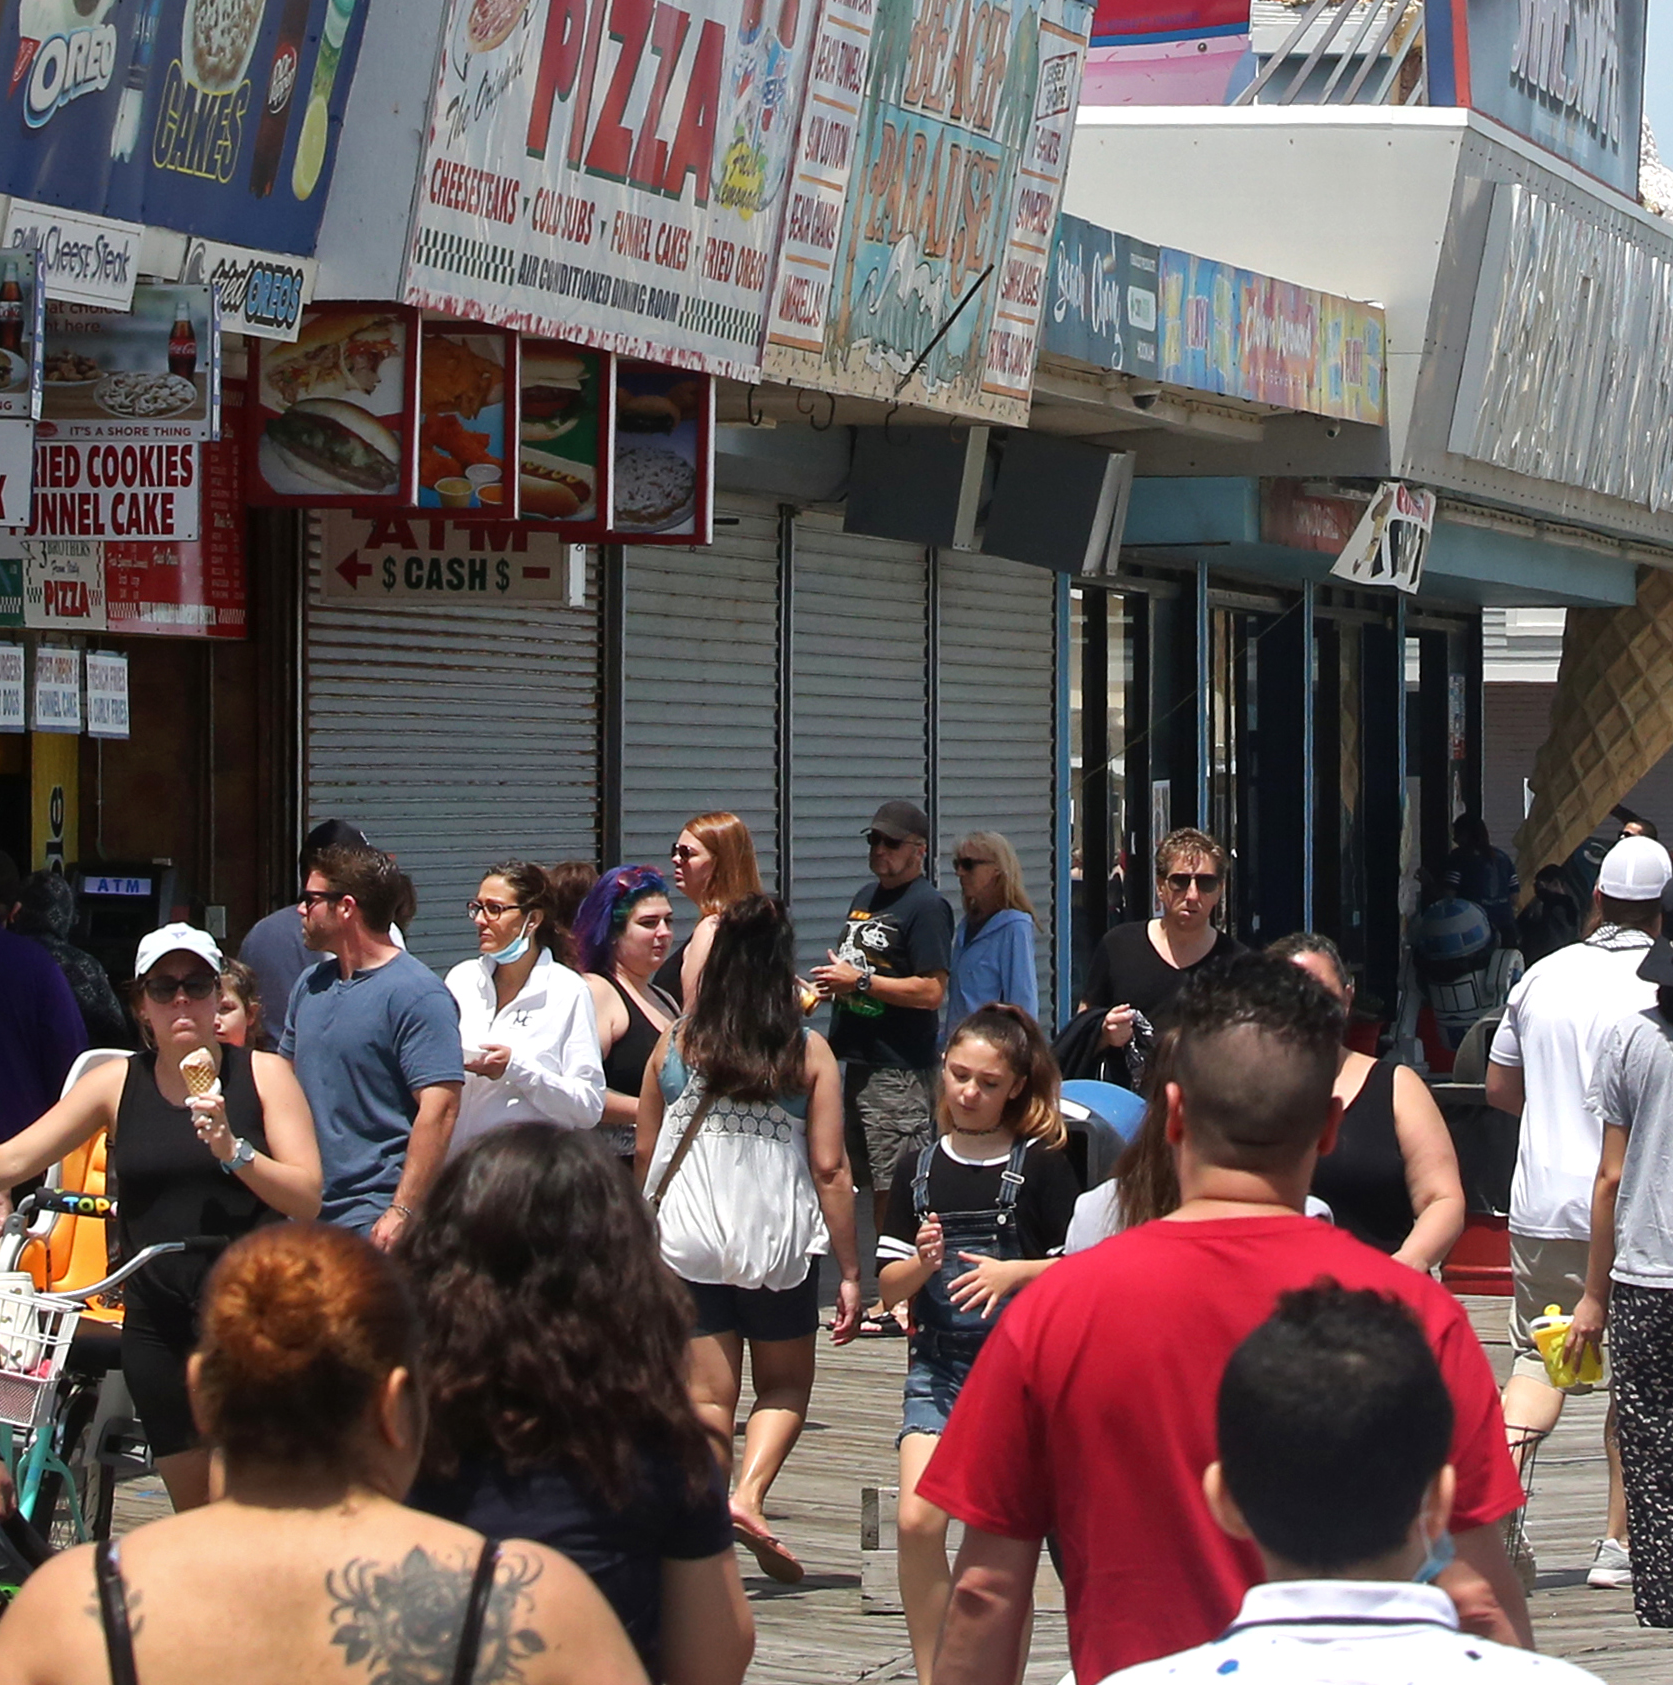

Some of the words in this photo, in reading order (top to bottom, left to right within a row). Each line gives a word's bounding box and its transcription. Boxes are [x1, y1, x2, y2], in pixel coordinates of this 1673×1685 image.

[28, 26, 116, 127] OREO
[152, 58, 251, 183] CAKES
[430, 157, 521, 225] CHEESESTEAKS
[531, 187, 561, 237] COLD
[562, 198, 597, 245] SUBS
[612, 210, 654, 264] FUNNEL
[656, 222, 692, 271] CAKES
[704, 235, 734, 283] FRIED
[735, 245, 767, 292] OREOS
[866, 120, 999, 300] PARADISE
[246, 262, 303, 328] OREOS
[518, 253, 537, 289] AIR
[538, 259, 610, 305] CONDITIONED
[611, 277, 646, 314] DINING
[647, 284, 679, 323] ROOM
[69, 426, 93, 436] IT'S
[96, 426, 105, 436] A
[108, 427, 151, 436] SHORE
[154, 427, 191, 437] THING
[87, 444, 193, 488] COOKIES
[111, 492, 174, 536] CAKE
[382, 555, 397, 592] $
[404, 557, 486, 591] CASH
[495, 555, 510, 592] $
[44, 581, 91, 617] PIZZA
[39, 689, 60, 716] FUNNEL
[97, 879, 139, 894] ATM
